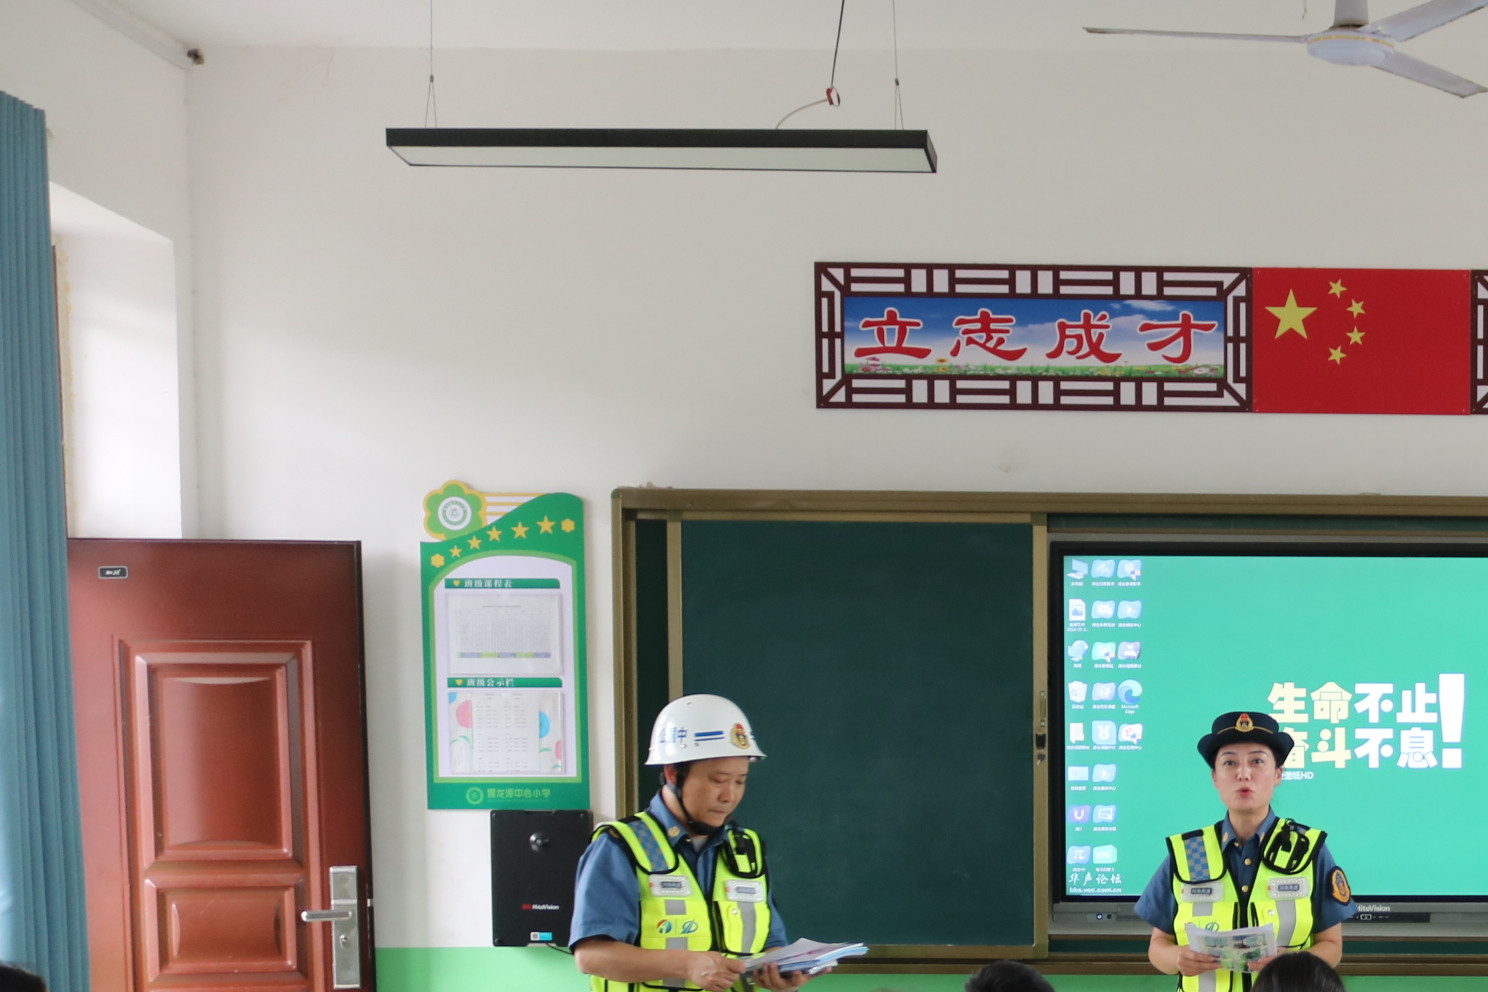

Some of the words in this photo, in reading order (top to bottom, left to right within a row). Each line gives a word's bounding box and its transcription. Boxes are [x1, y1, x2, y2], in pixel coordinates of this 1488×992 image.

[853, 306, 1218, 364] 立志成才
[1267, 681, 1438, 724] 生命不止
